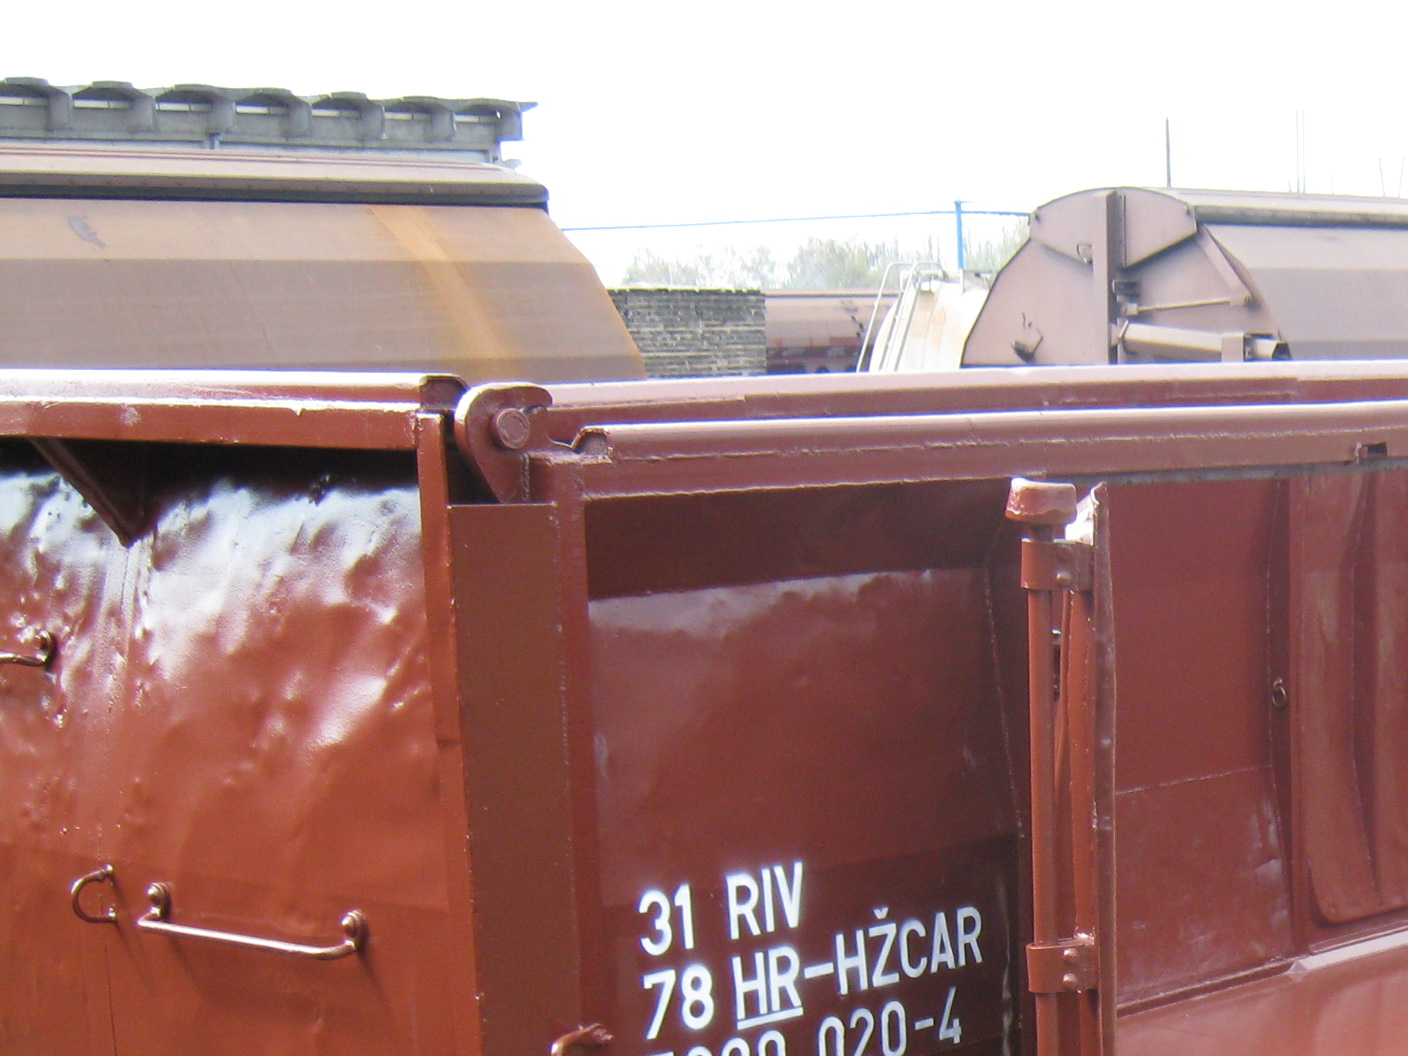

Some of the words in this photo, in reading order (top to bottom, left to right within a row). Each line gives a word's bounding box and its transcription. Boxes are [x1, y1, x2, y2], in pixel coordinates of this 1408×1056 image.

[638, 882, 695, 956] 31
[725, 861, 804, 940] RIV
[642, 963, 716, 1041] 78
[731, 906, 984, 1030] HR-HŽCAR
